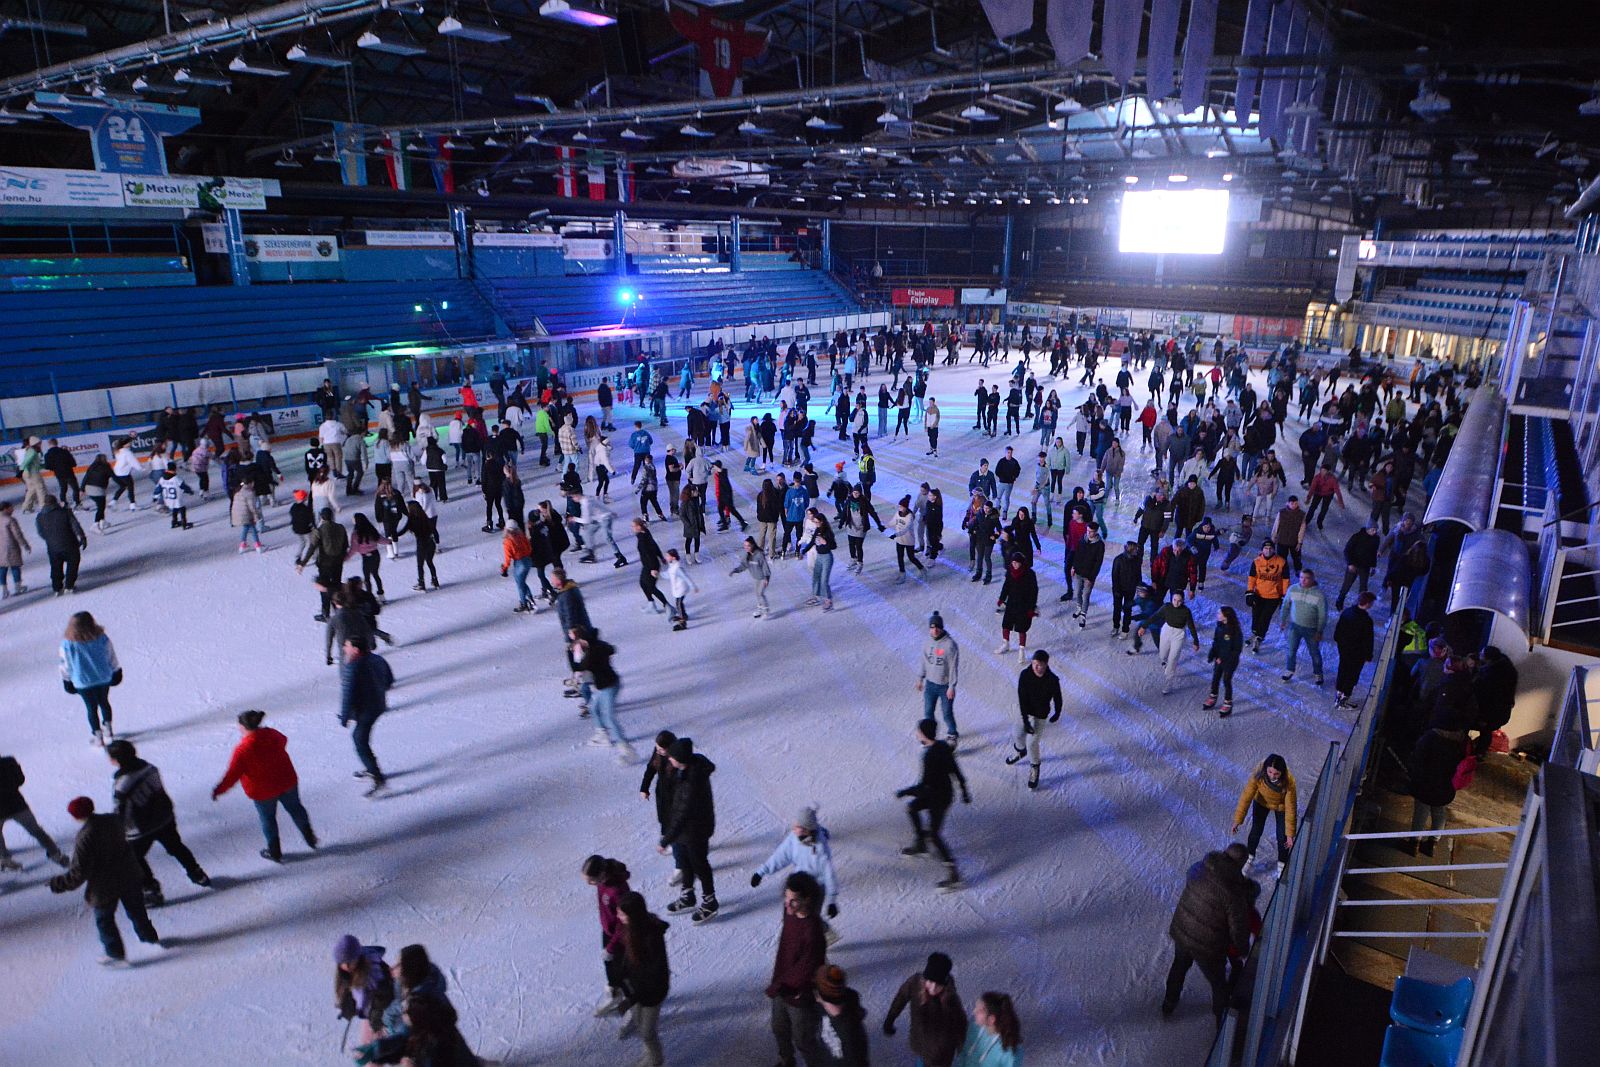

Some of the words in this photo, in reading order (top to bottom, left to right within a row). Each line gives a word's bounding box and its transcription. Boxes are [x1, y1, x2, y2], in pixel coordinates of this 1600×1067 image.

[713, 36, 731, 69] 19
[107, 115, 145, 142] 24
[910, 295, 939, 305] Fairplay
